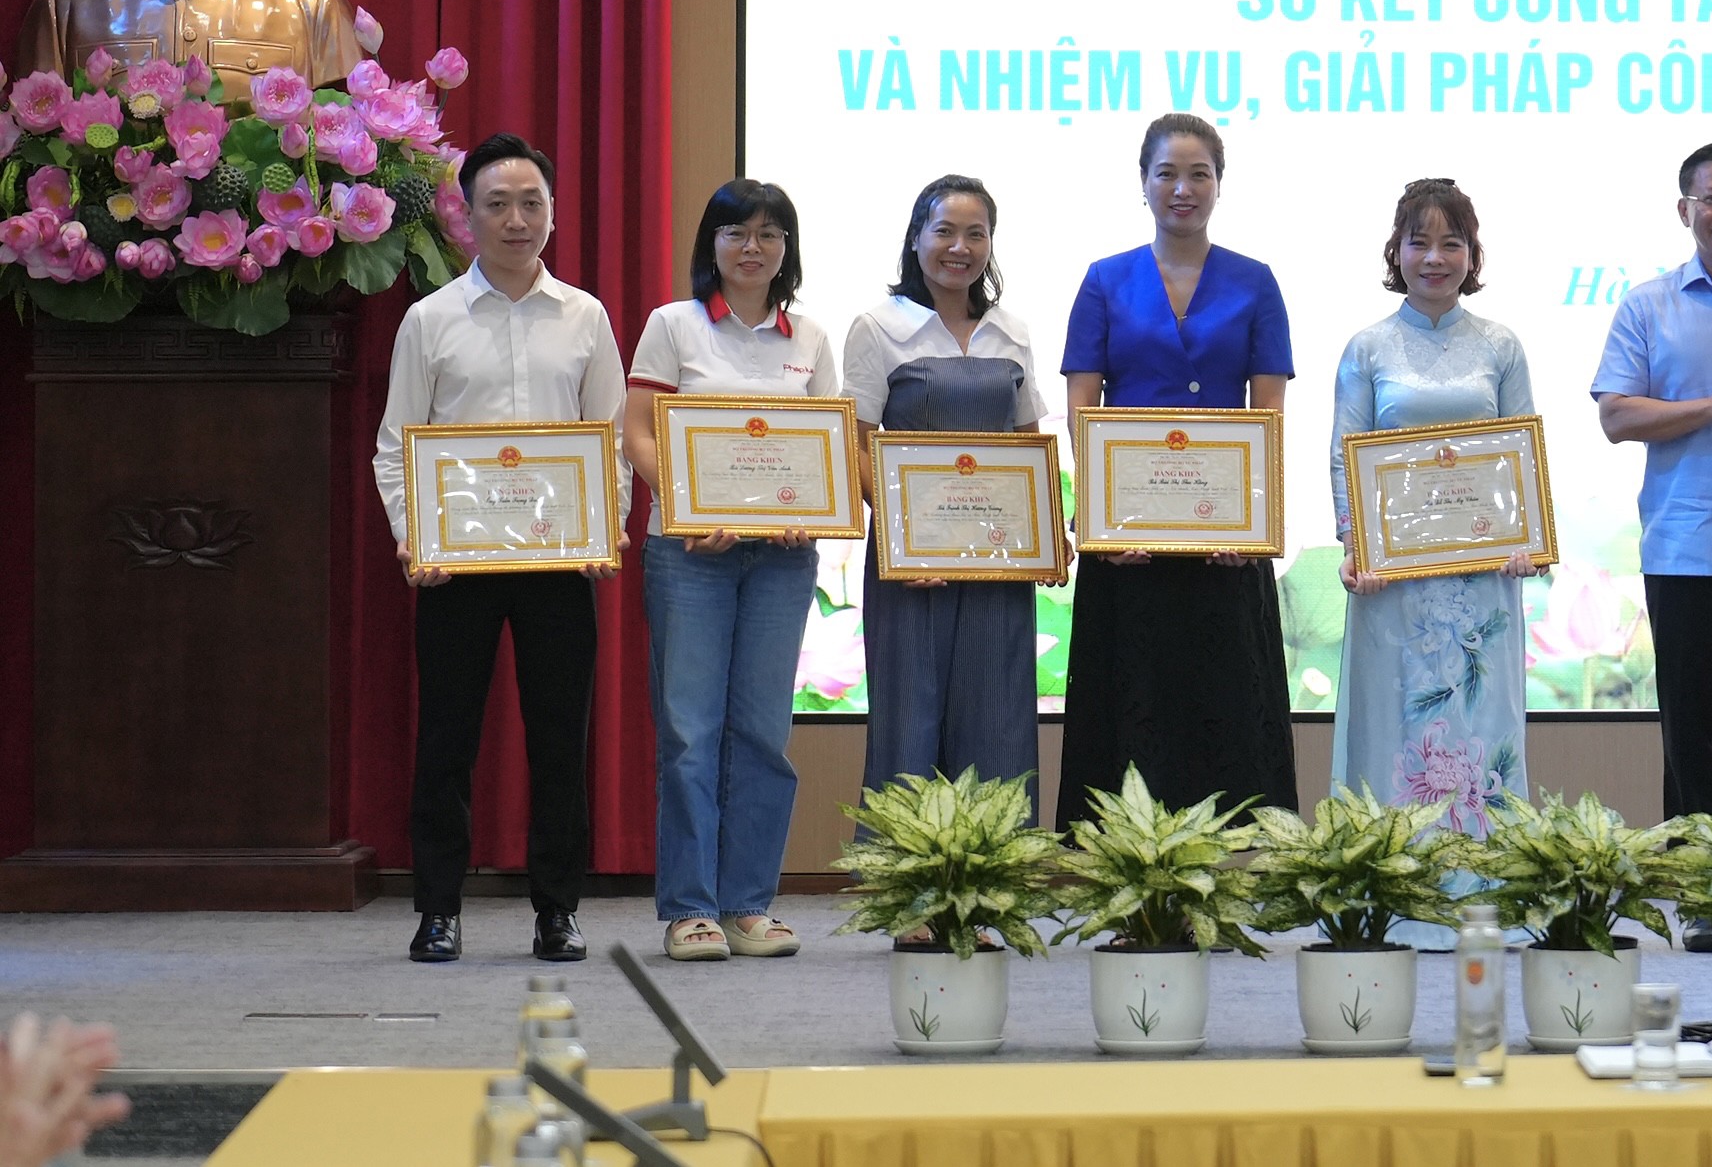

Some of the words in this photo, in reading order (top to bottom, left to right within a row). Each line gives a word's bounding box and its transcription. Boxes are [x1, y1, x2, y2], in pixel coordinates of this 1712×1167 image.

[837, 36, 917, 111] VÀ
[940, 36, 1142, 126] NHIỆM
[1165, 50, 1261, 126] VỤ,
[1284, 29, 1405, 112] GIẢI
[1431, 39, 1594, 113] PHÁP
